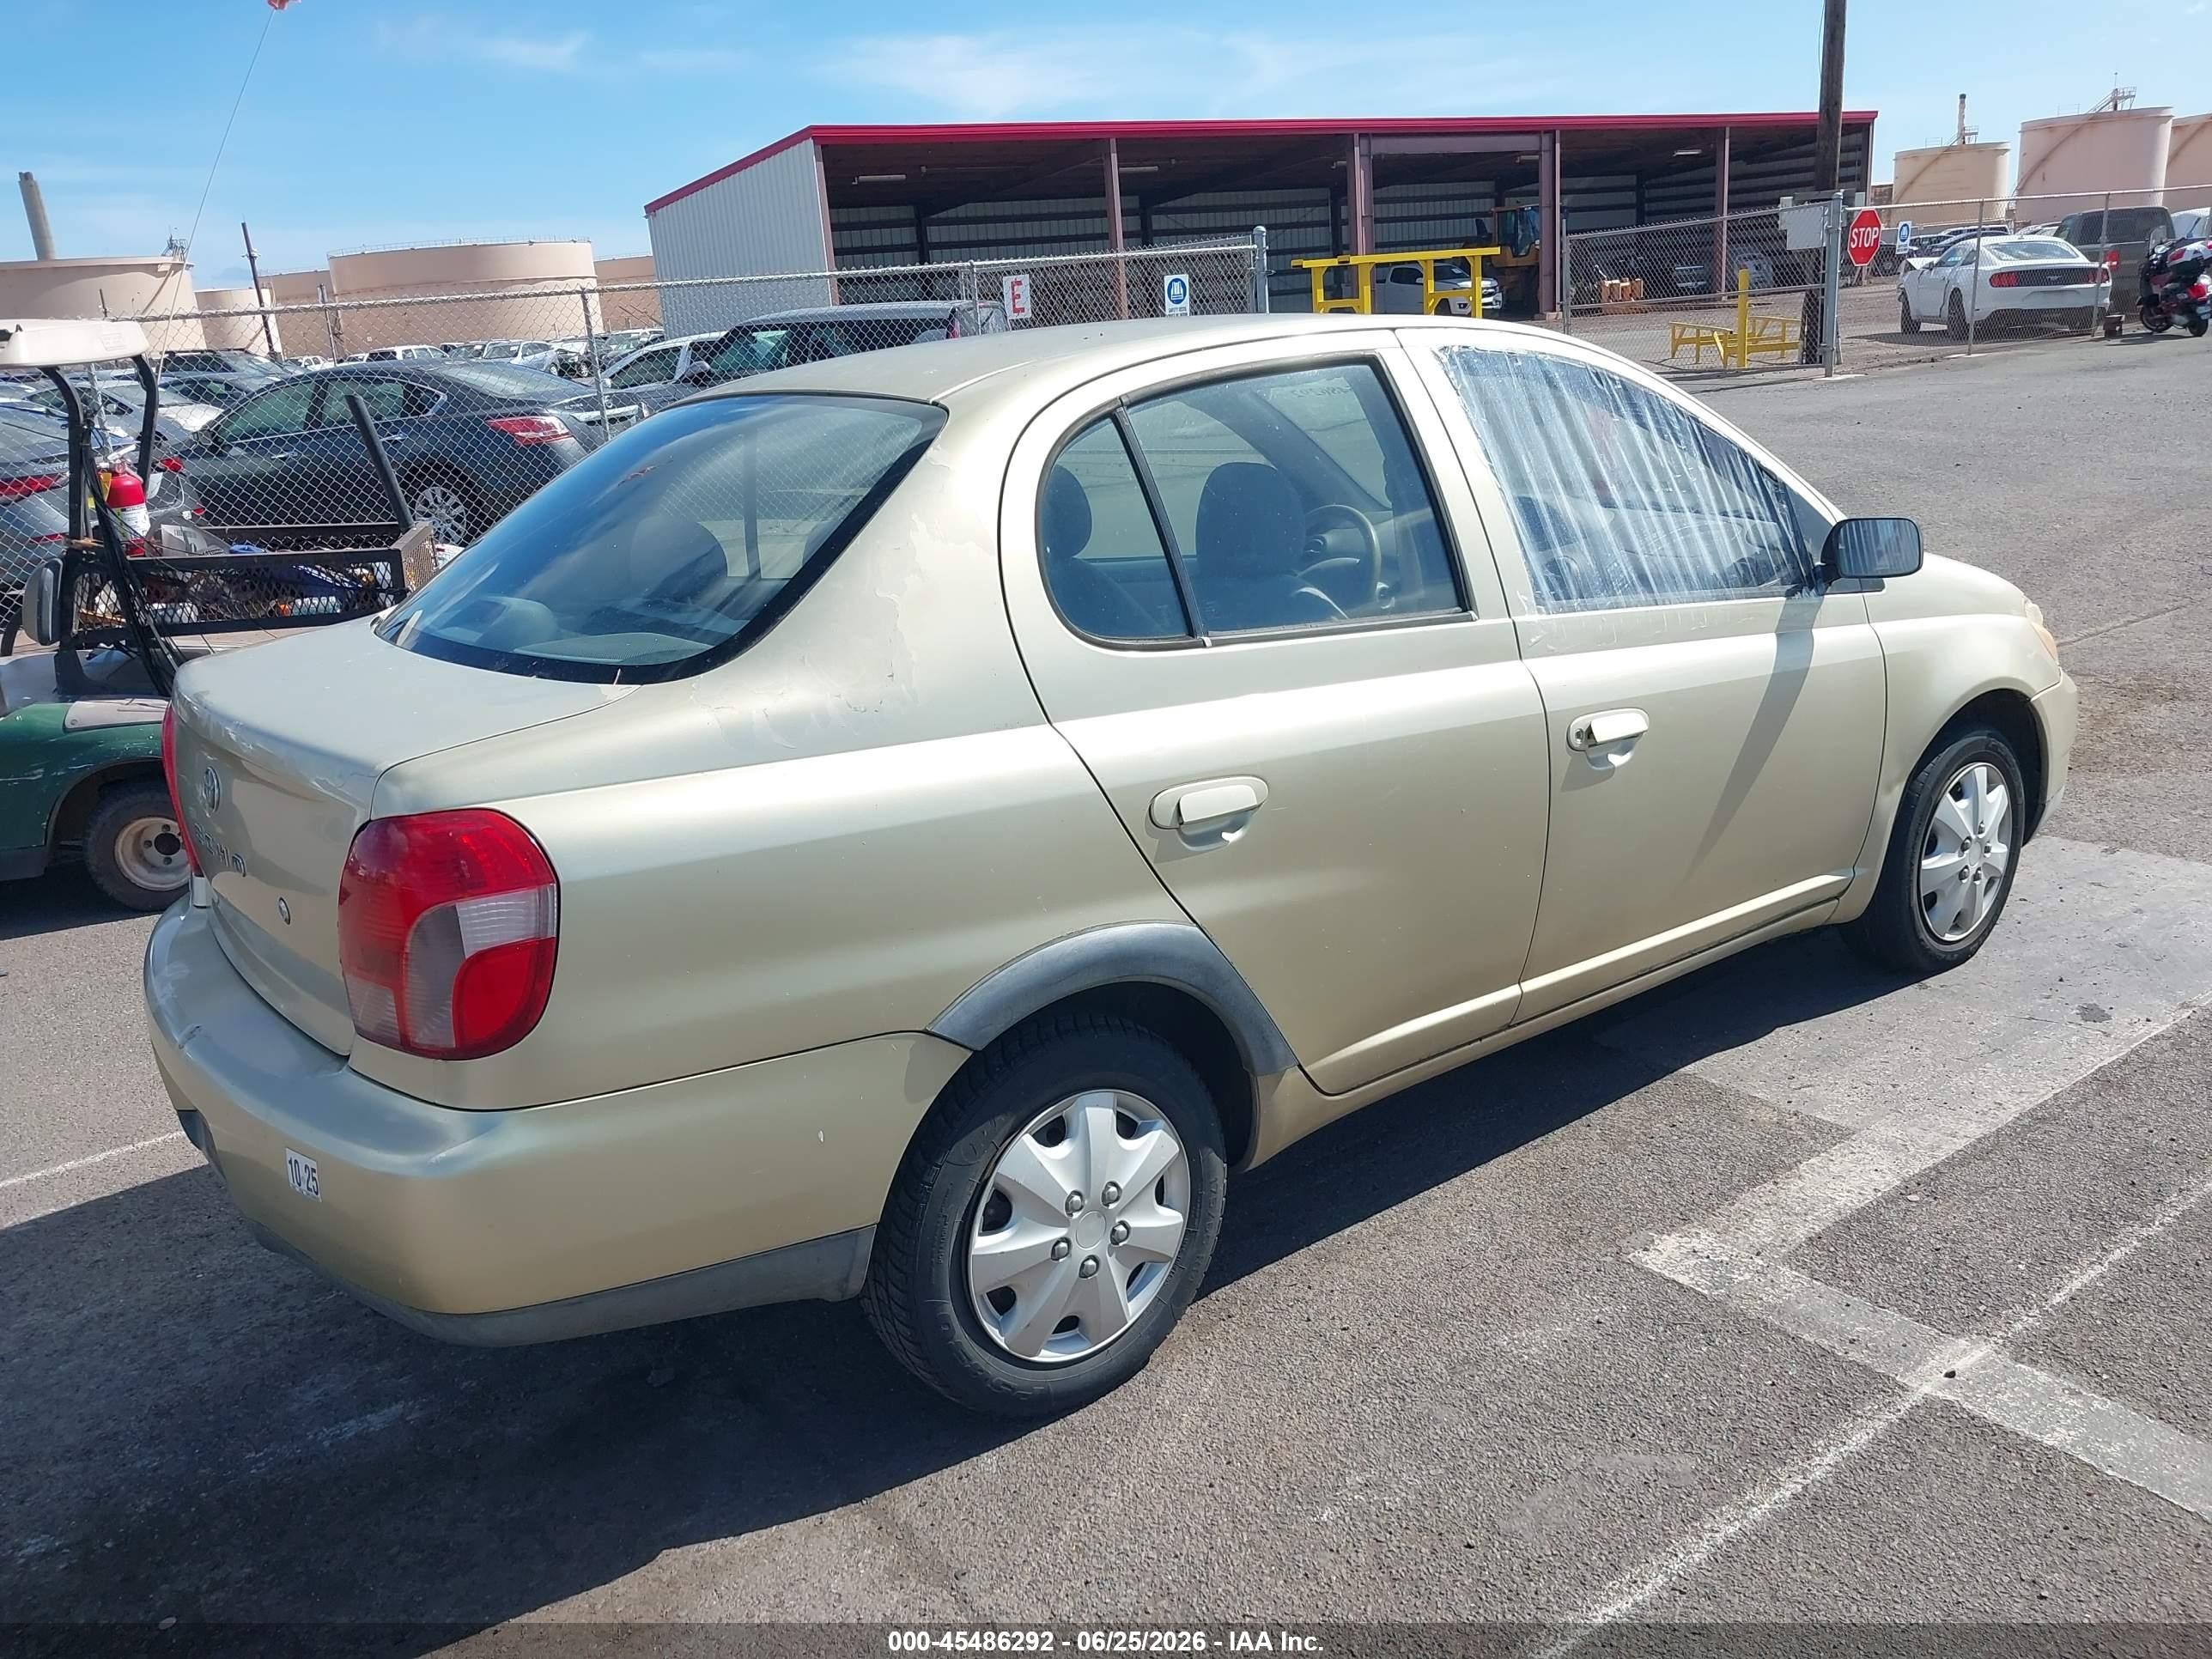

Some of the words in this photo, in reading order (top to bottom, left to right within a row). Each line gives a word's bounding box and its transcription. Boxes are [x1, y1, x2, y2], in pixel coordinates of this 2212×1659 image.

[1850, 227, 1879, 248] STOP
[1010, 278, 1025, 315] E
[288, 1157, 301, 1187] 10
[304, 1164, 319, 1196] 25
